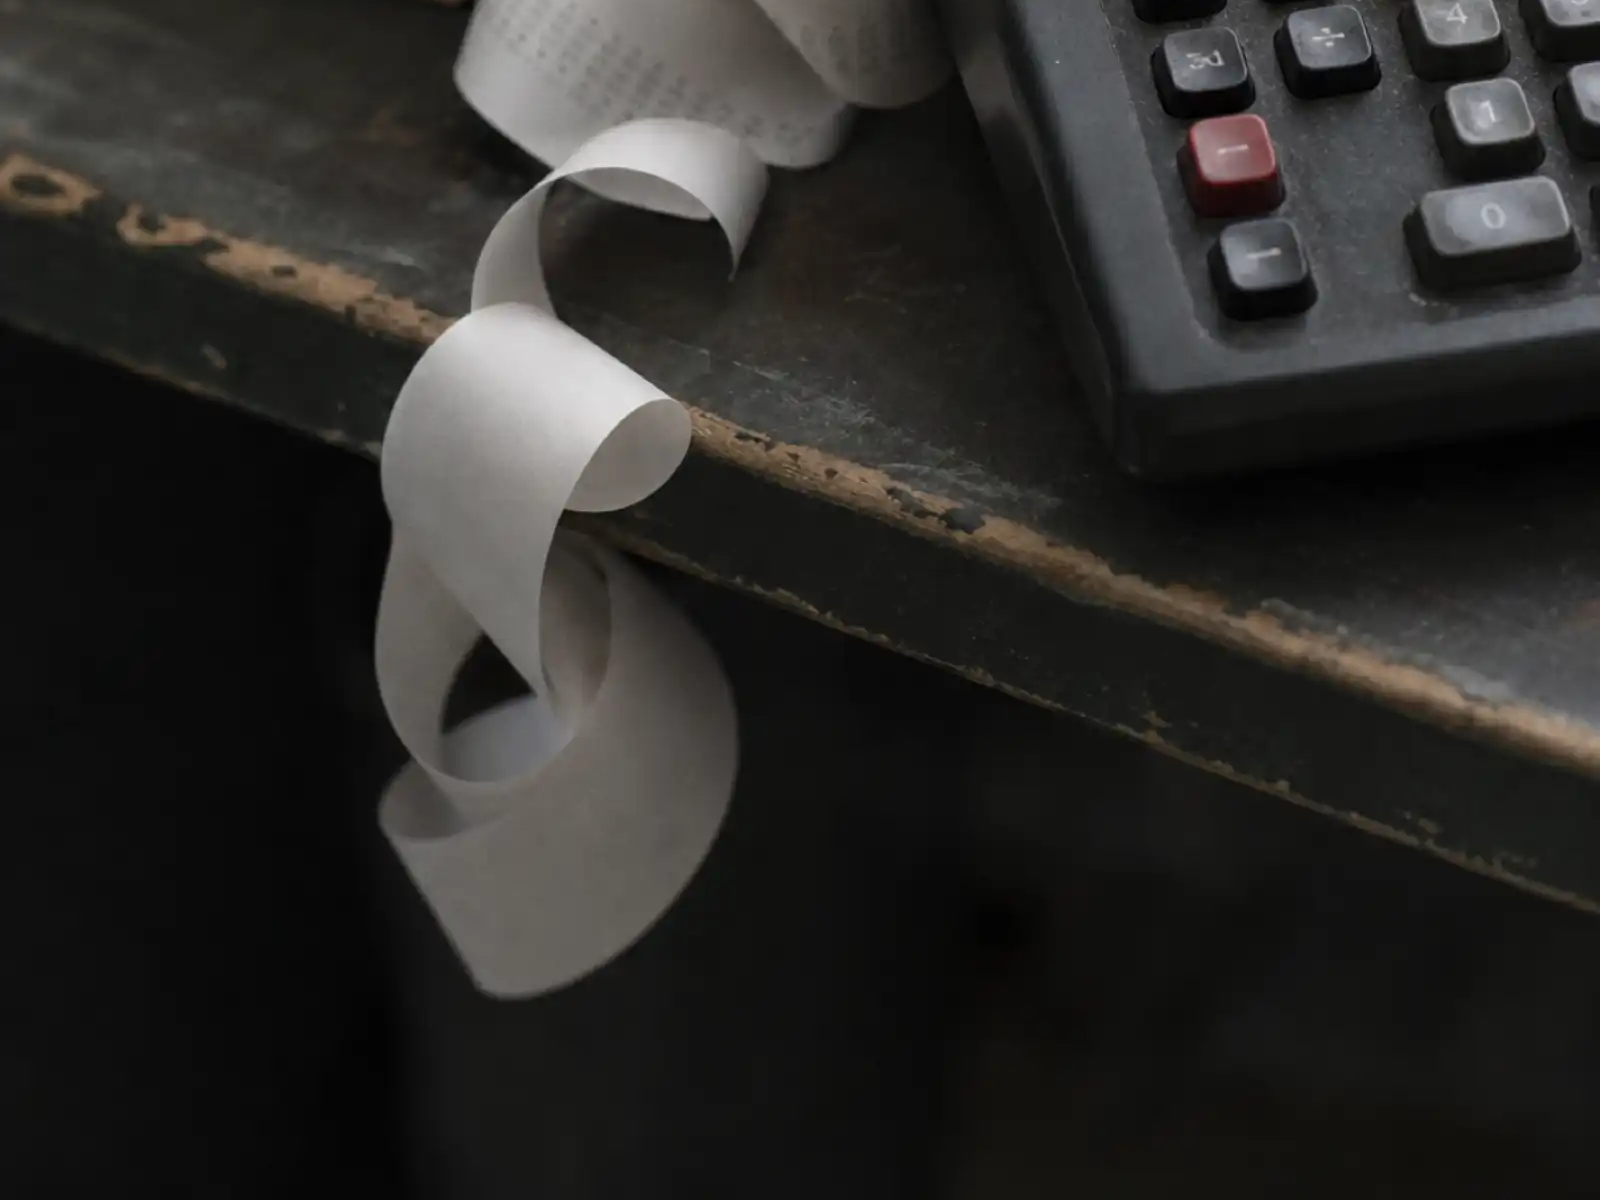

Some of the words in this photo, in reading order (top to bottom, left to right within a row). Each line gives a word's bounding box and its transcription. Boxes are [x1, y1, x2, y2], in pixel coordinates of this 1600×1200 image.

[1446, 2, 1468, 24] 4
[1479, 99, 1497, 123] 1
[1481, 202, 1506, 229] 0
